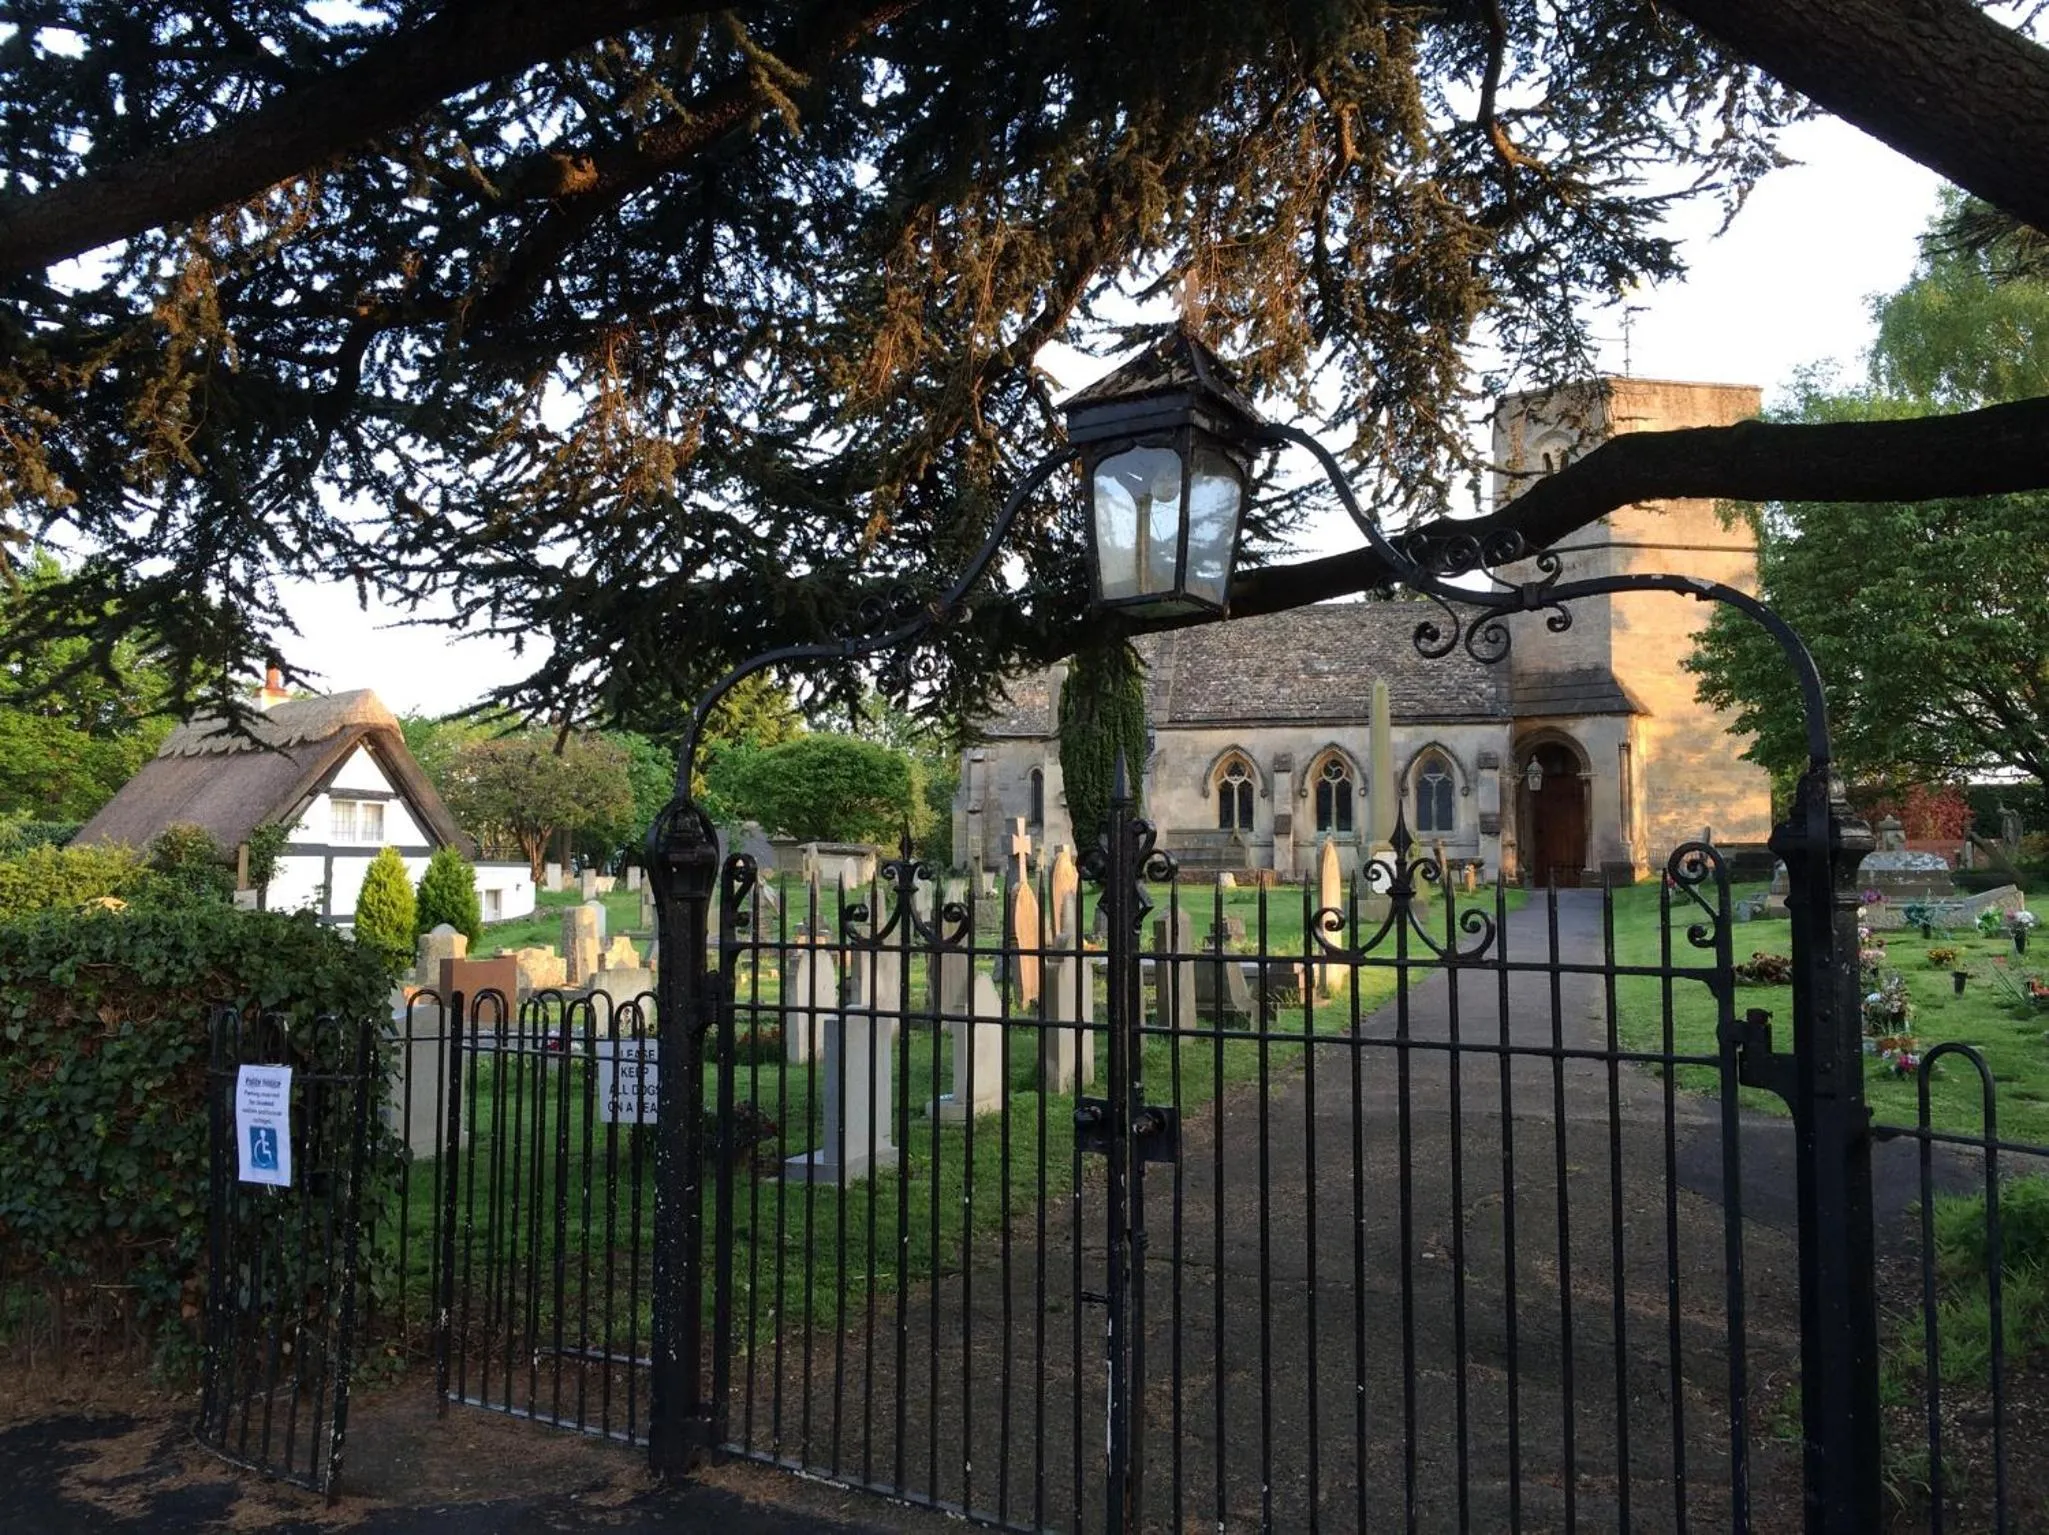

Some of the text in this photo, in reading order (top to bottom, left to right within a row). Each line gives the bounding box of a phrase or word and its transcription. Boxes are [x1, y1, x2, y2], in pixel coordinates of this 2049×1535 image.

[619, 1049, 655, 1060] LEASE
[621, 1067, 649, 1078] KEP
[609, 1083, 628, 1095] AL
[626, 1102, 633, 1113] A
[637, 1102, 658, 1114] EA
